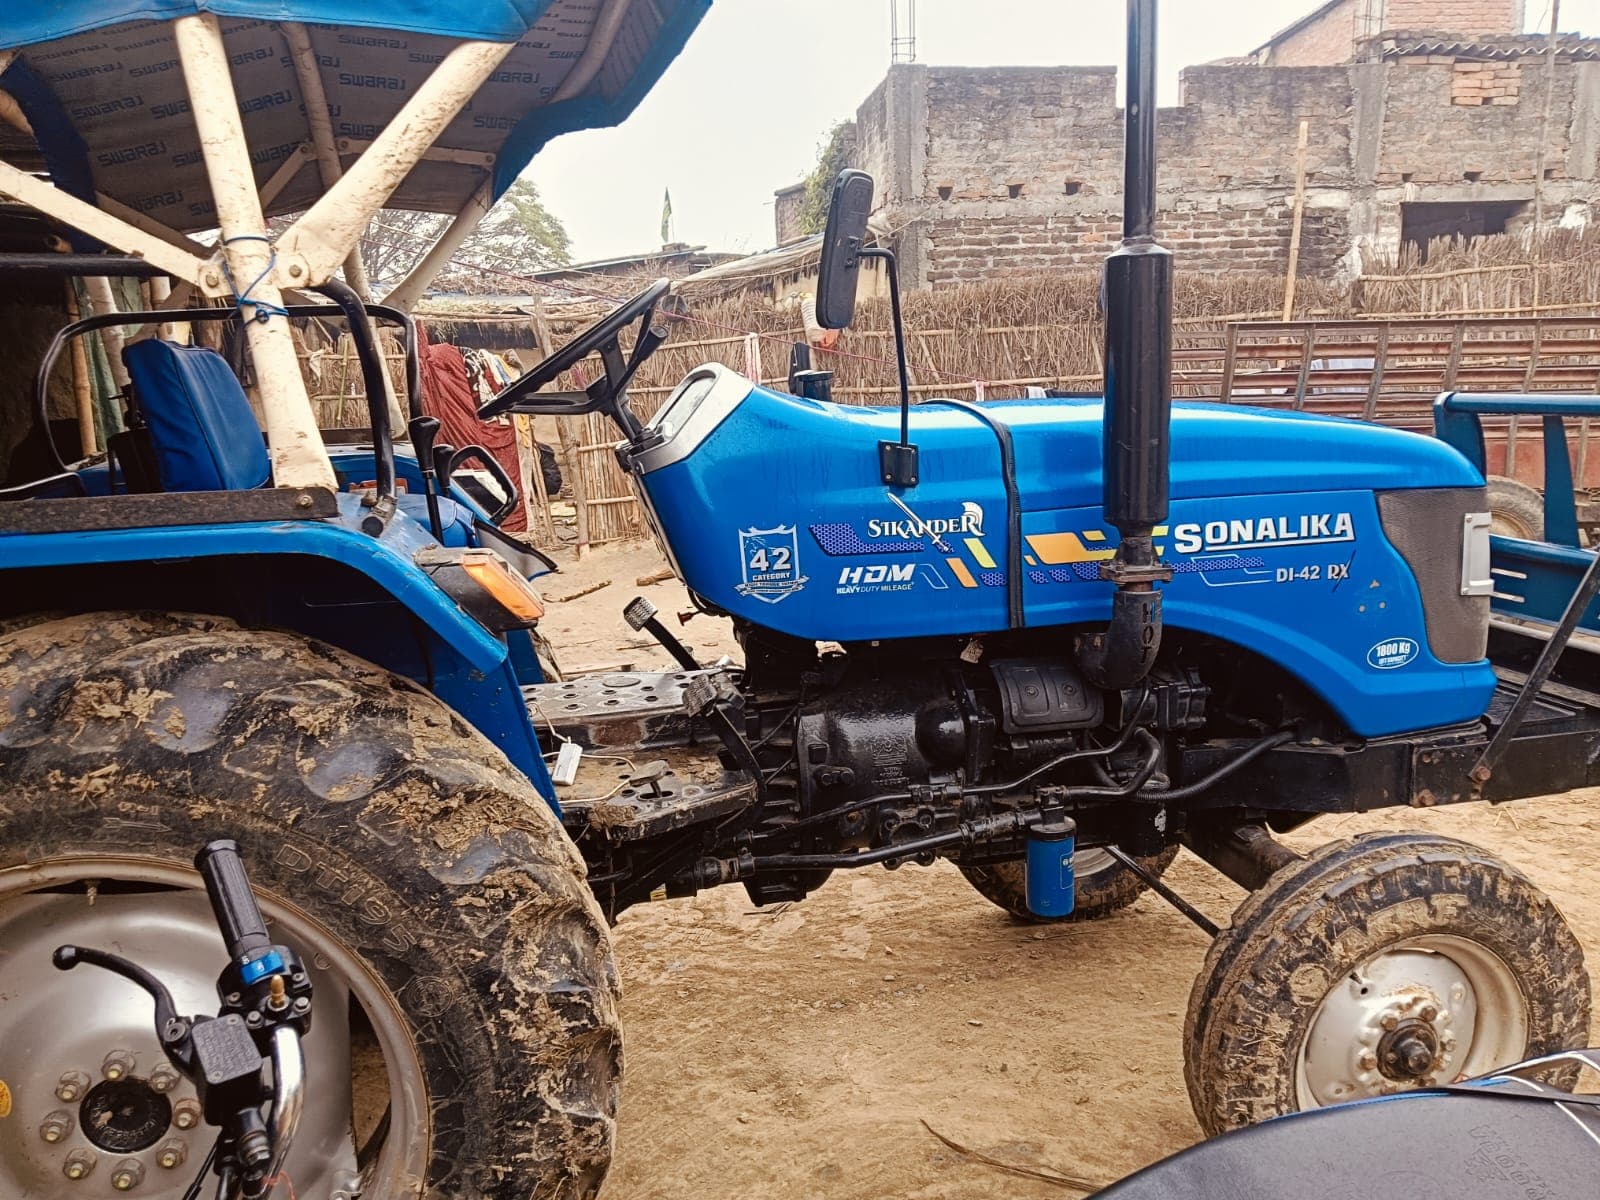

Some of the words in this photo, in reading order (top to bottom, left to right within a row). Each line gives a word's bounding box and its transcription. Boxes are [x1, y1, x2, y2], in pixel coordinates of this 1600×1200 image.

[868, 514, 985, 539] SIKANDER
[1174, 512, 1355, 554] SONALIKA
[749, 547, 792, 572] 42
[752, 572, 790, 582] CATEGORY
[838, 563, 916, 585] HDM
[1276, 566, 1320, 583] DI-42
